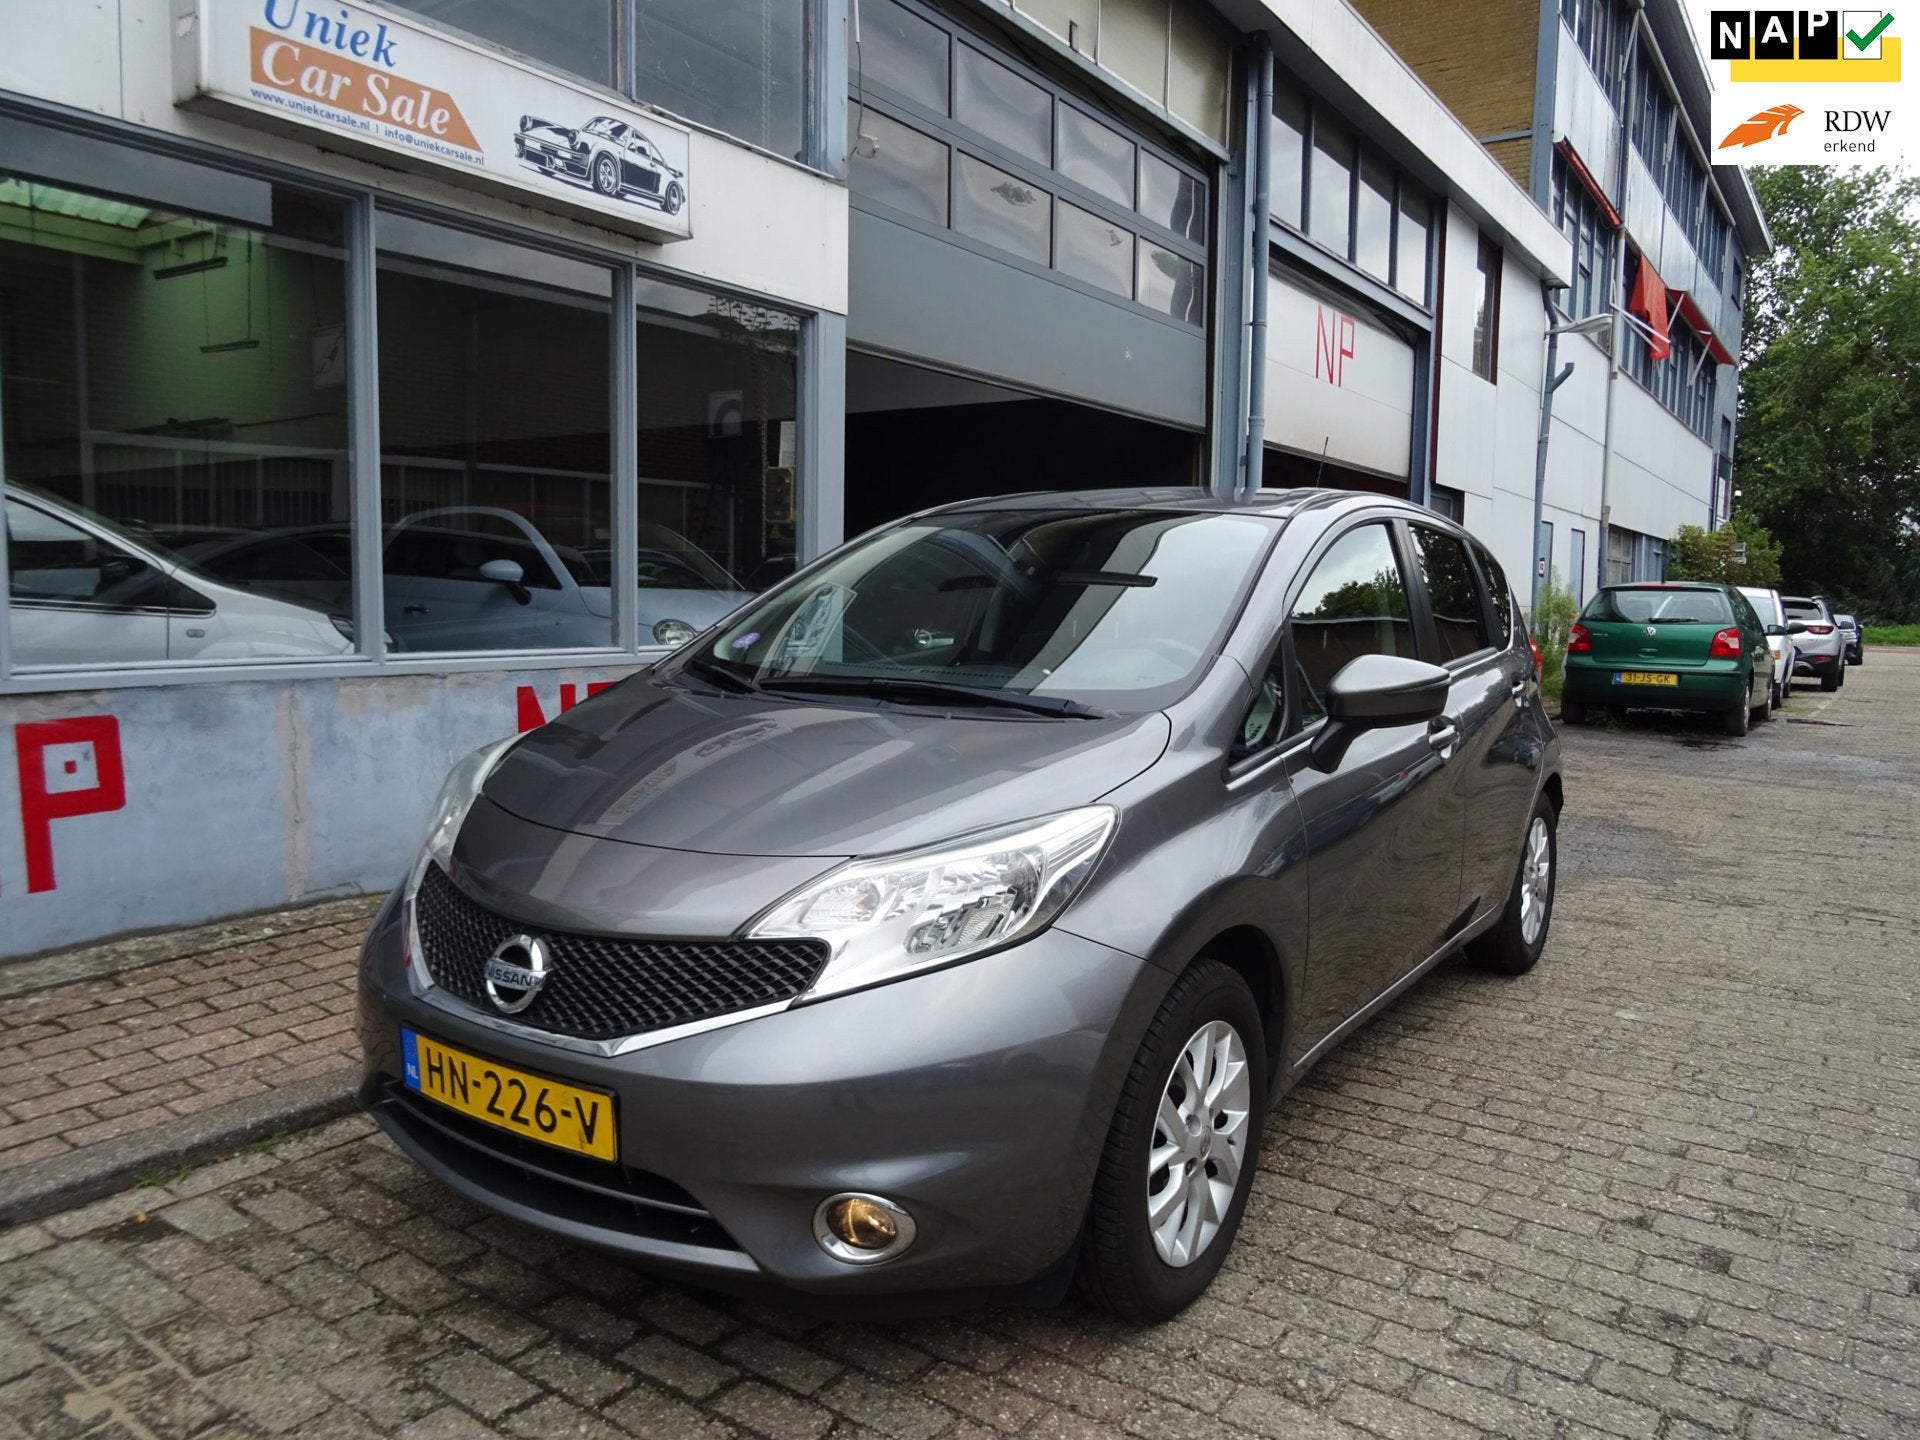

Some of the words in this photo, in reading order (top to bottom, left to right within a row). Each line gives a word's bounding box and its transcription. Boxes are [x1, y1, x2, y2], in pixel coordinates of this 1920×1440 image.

[264, 0, 397, 67] Uniek
[262, 40, 352, 101] Car
[363, 73, 450, 135] Sale
[250, 88, 370, 131] www.uniekcarsale.nl
[384, 126, 485, 166] info@uniekcarsale.nl
[1315, 303, 1355, 388] NP
[1625, 672, 1671, 685] 31-JS-GK
[486, 964, 533, 987] NISSAN
[406, 1063, 419, 1080] NL
[426, 1046, 599, 1145] HN-226-V
